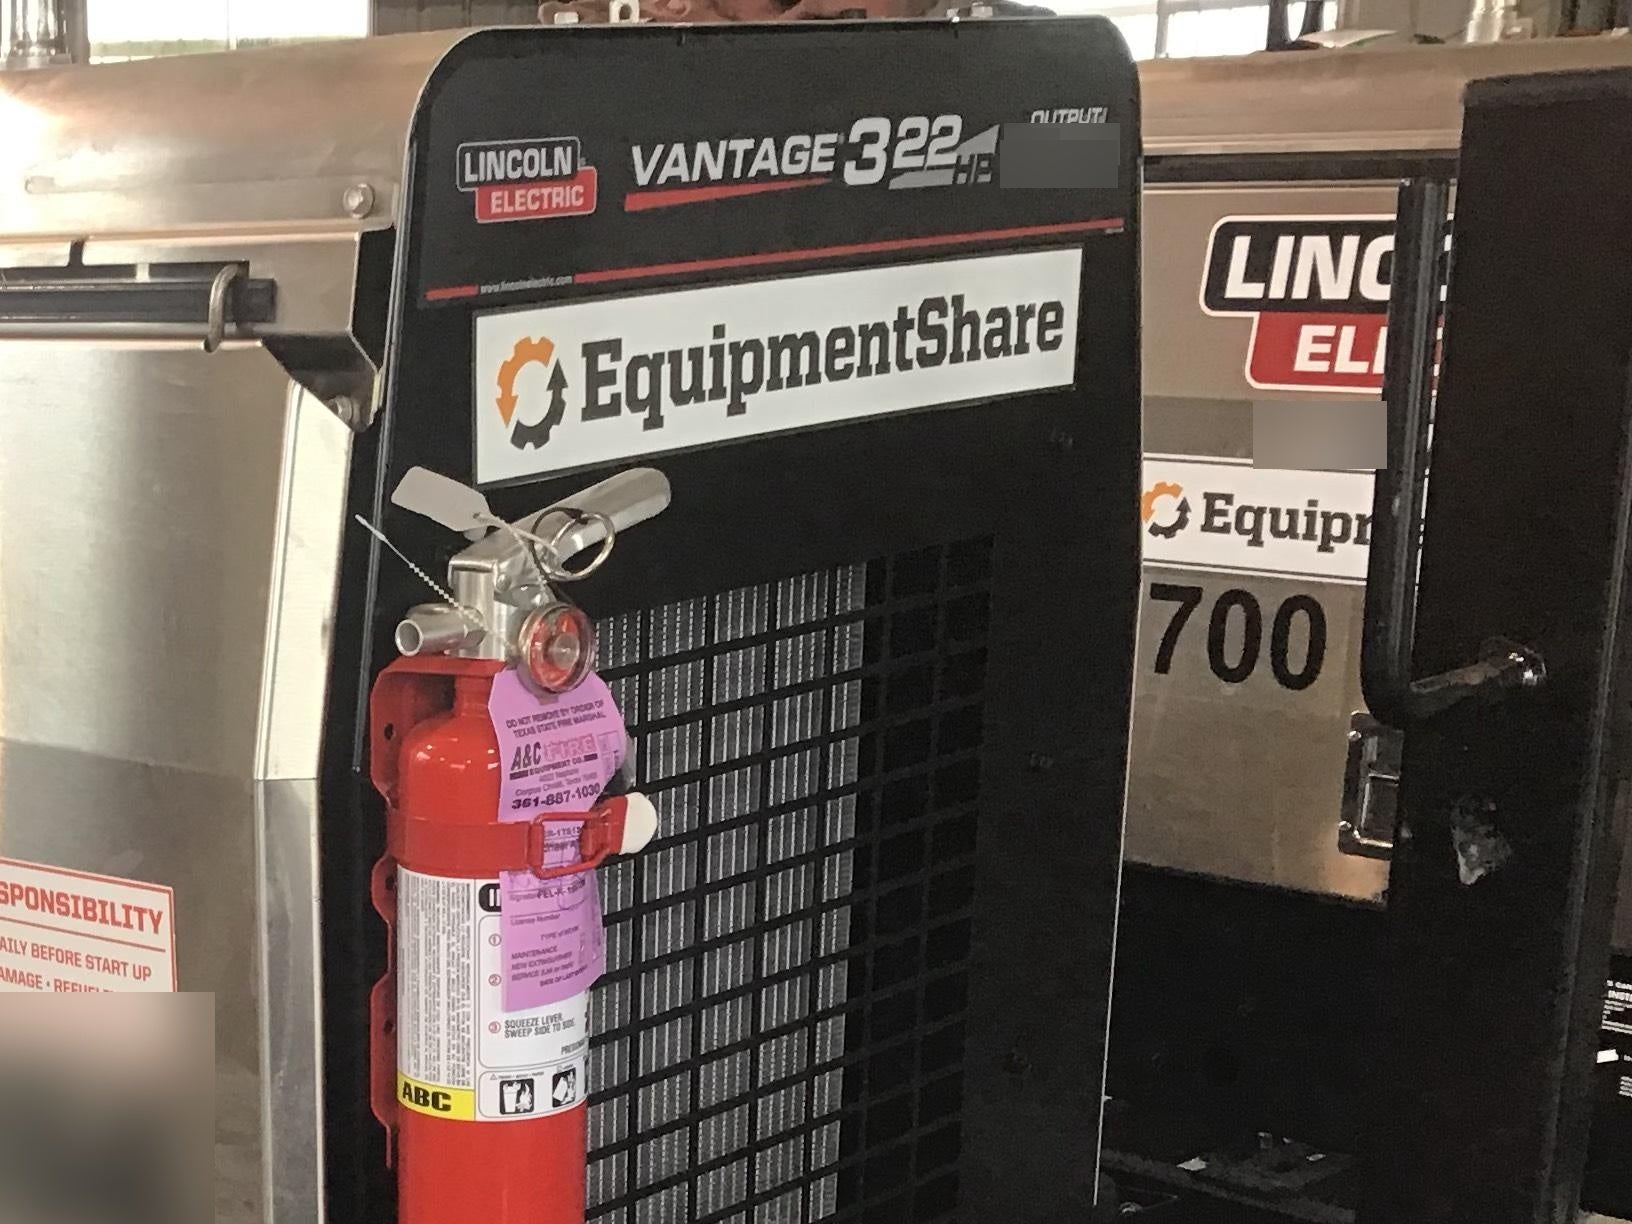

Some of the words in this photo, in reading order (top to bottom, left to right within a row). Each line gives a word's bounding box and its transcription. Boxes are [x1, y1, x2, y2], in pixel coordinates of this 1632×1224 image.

[464, 145, 573, 183] LINCOLN
[631, 132, 838, 187] VANTAGE
[843, 114, 963, 186] 322
[490, 184, 584, 214] ELECTRIC
[1223, 234, 1396, 301] LINC
[580, 294, 1065, 432] EquipmentShare
[1149, 582, 1328, 691] 700
[513, 727, 536, 738] TEXAS
[511, 742, 541, 771] A&C
[31, 943, 82, 968] BEFORE
[85, 955, 129, 978] START
[133, 964, 152, 982] UP
[504, 1017, 540, 1029] SQUEEZE
[504, 1028, 533, 1039] SWEEP
[534, 1024, 551, 1036] SIDE
[553, 1022, 561, 1032] TO
[402, 1084, 452, 1112] ABC
